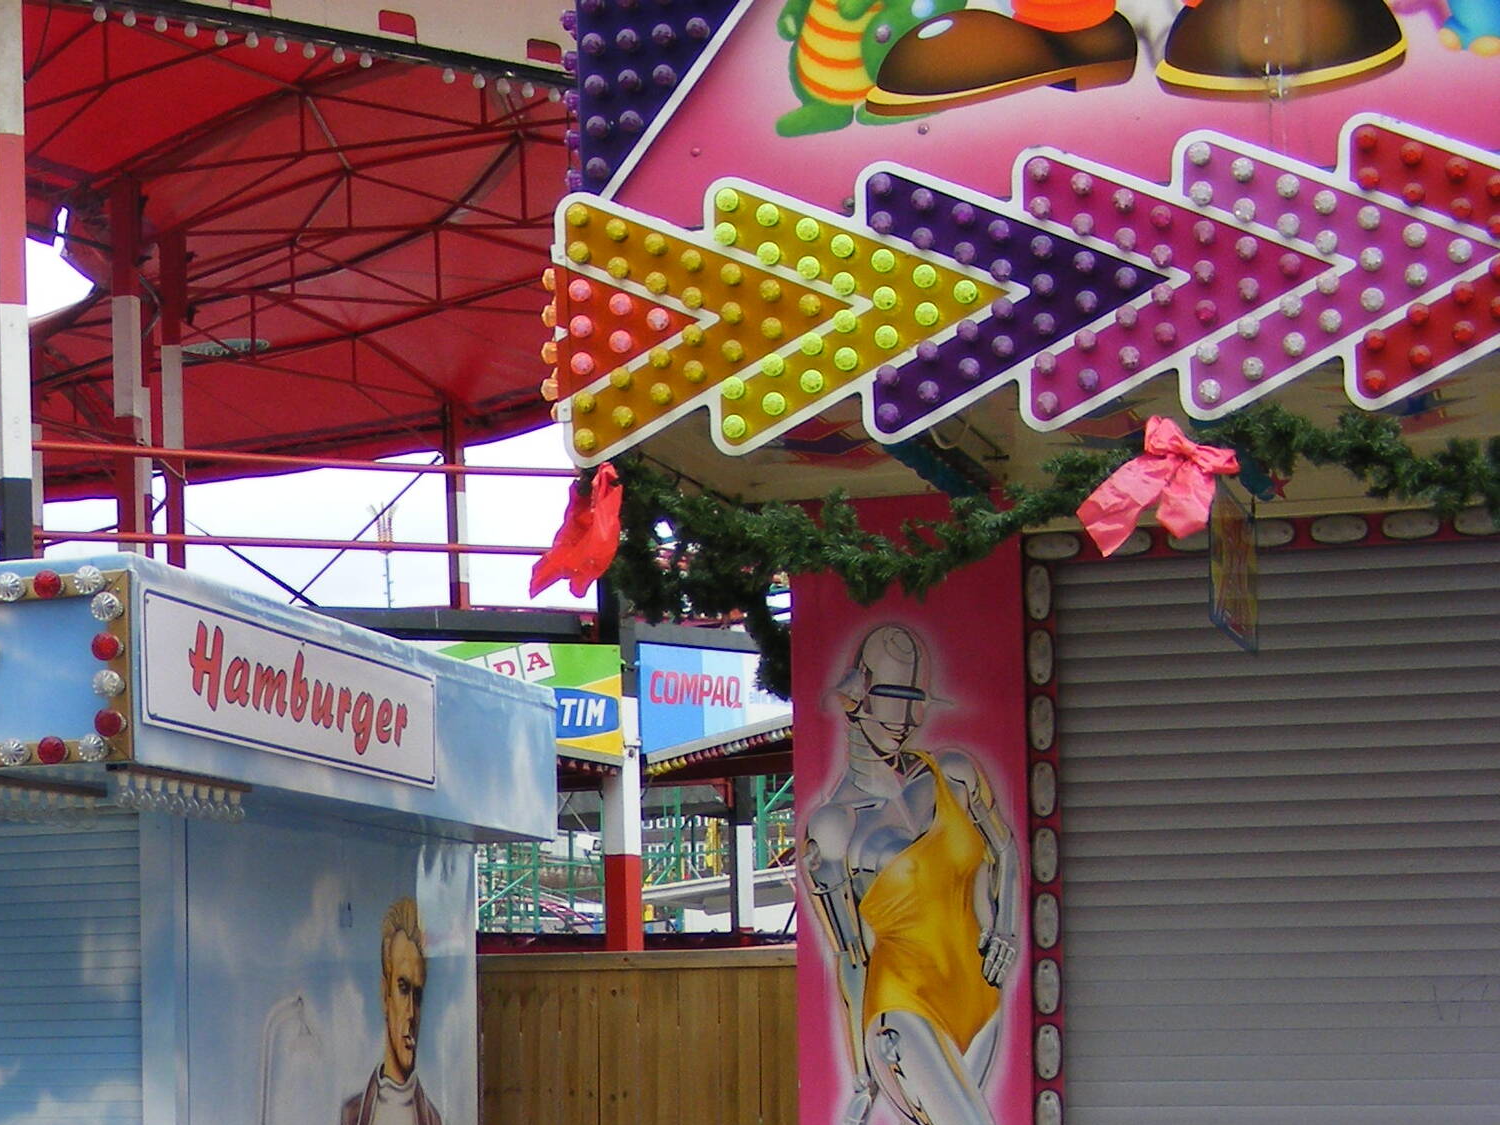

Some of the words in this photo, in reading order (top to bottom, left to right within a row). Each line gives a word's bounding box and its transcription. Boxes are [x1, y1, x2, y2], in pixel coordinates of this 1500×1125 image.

[188, 619, 409, 757] Hamburger
[649, 670, 742, 709] COMPAQ
[560, 697, 606, 727] TIM
